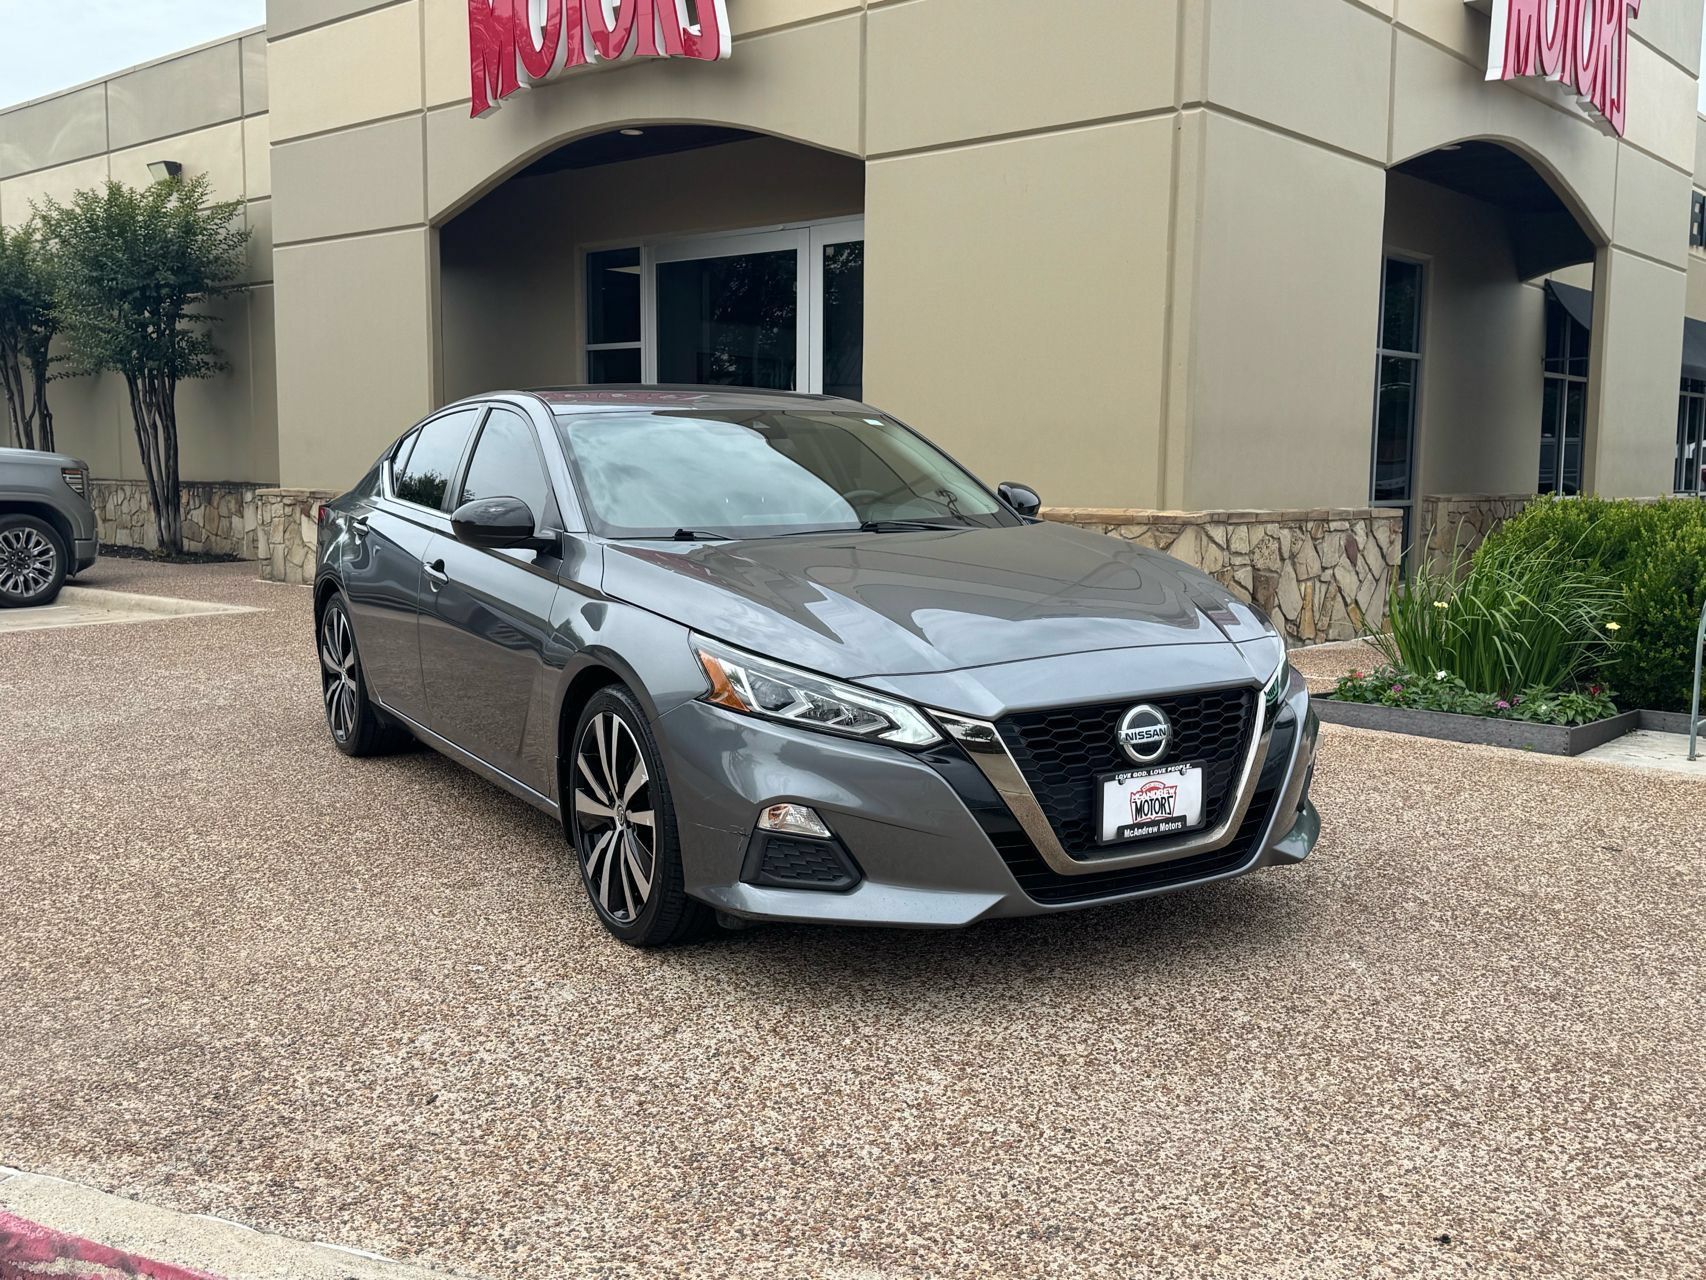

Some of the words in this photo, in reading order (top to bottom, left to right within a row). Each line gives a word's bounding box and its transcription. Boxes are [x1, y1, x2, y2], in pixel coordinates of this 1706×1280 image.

[1125, 728, 1167, 741] NISSAN
[1150, 768, 1166, 776] LOVE
[1167, 763, 1193, 772] PEOPLE.
[1132, 795, 1174, 821] MOTORS
[1124, 826, 1159, 838] McAndrew
[1159, 821, 1182, 832] Motors
